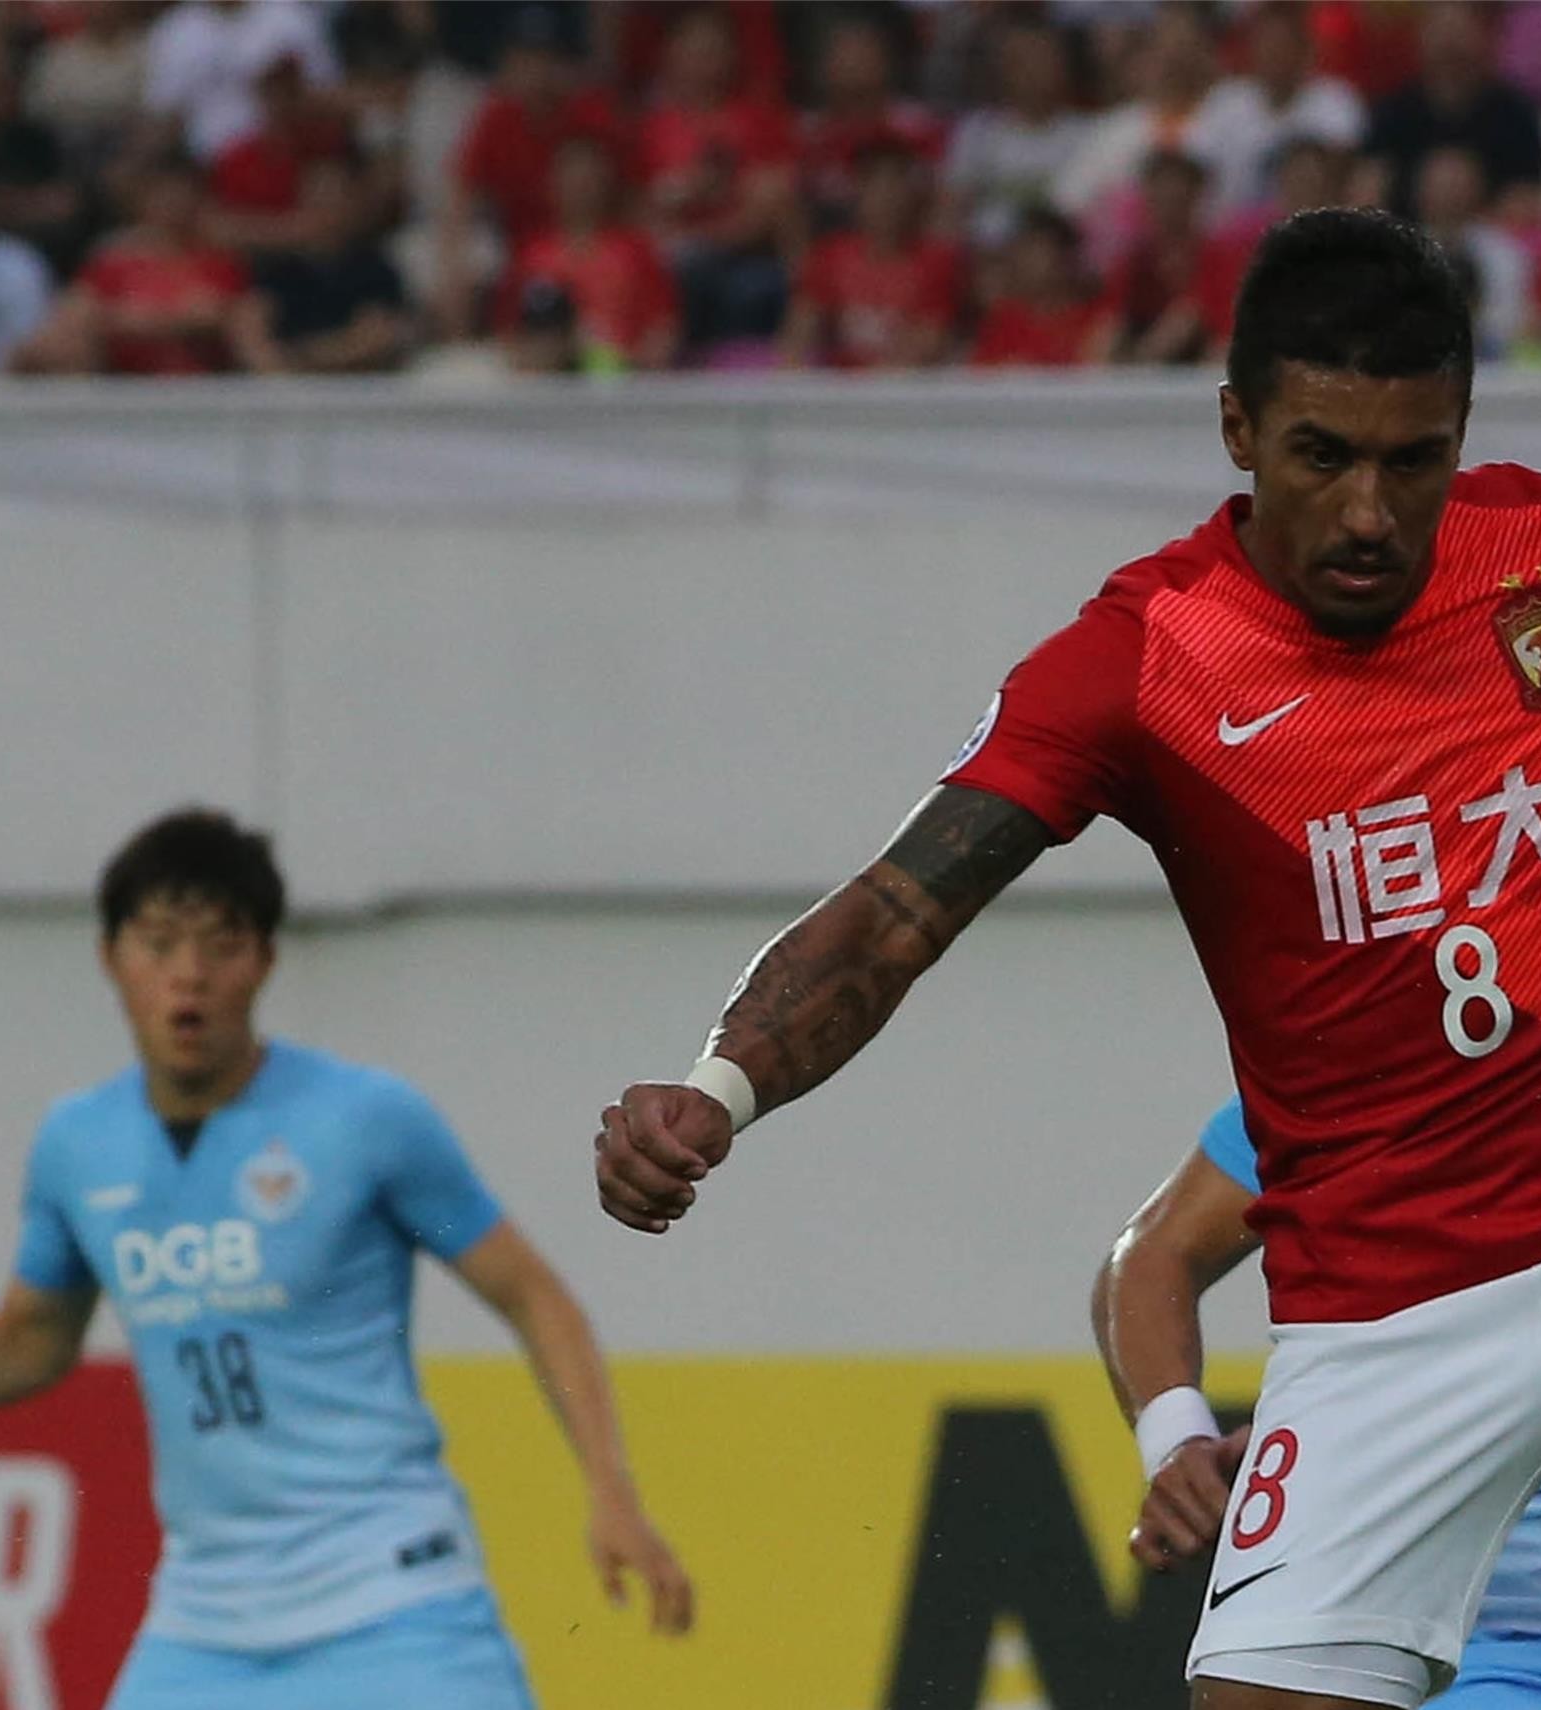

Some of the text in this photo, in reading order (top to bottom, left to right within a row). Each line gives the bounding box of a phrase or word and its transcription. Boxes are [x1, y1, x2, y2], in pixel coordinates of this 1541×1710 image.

[1434, 923, 1514, 1060] 8
[112, 1218, 262, 1296] DGB
[176, 1330, 267, 1434] 38
[1230, 1426, 1299, 1551] 8
